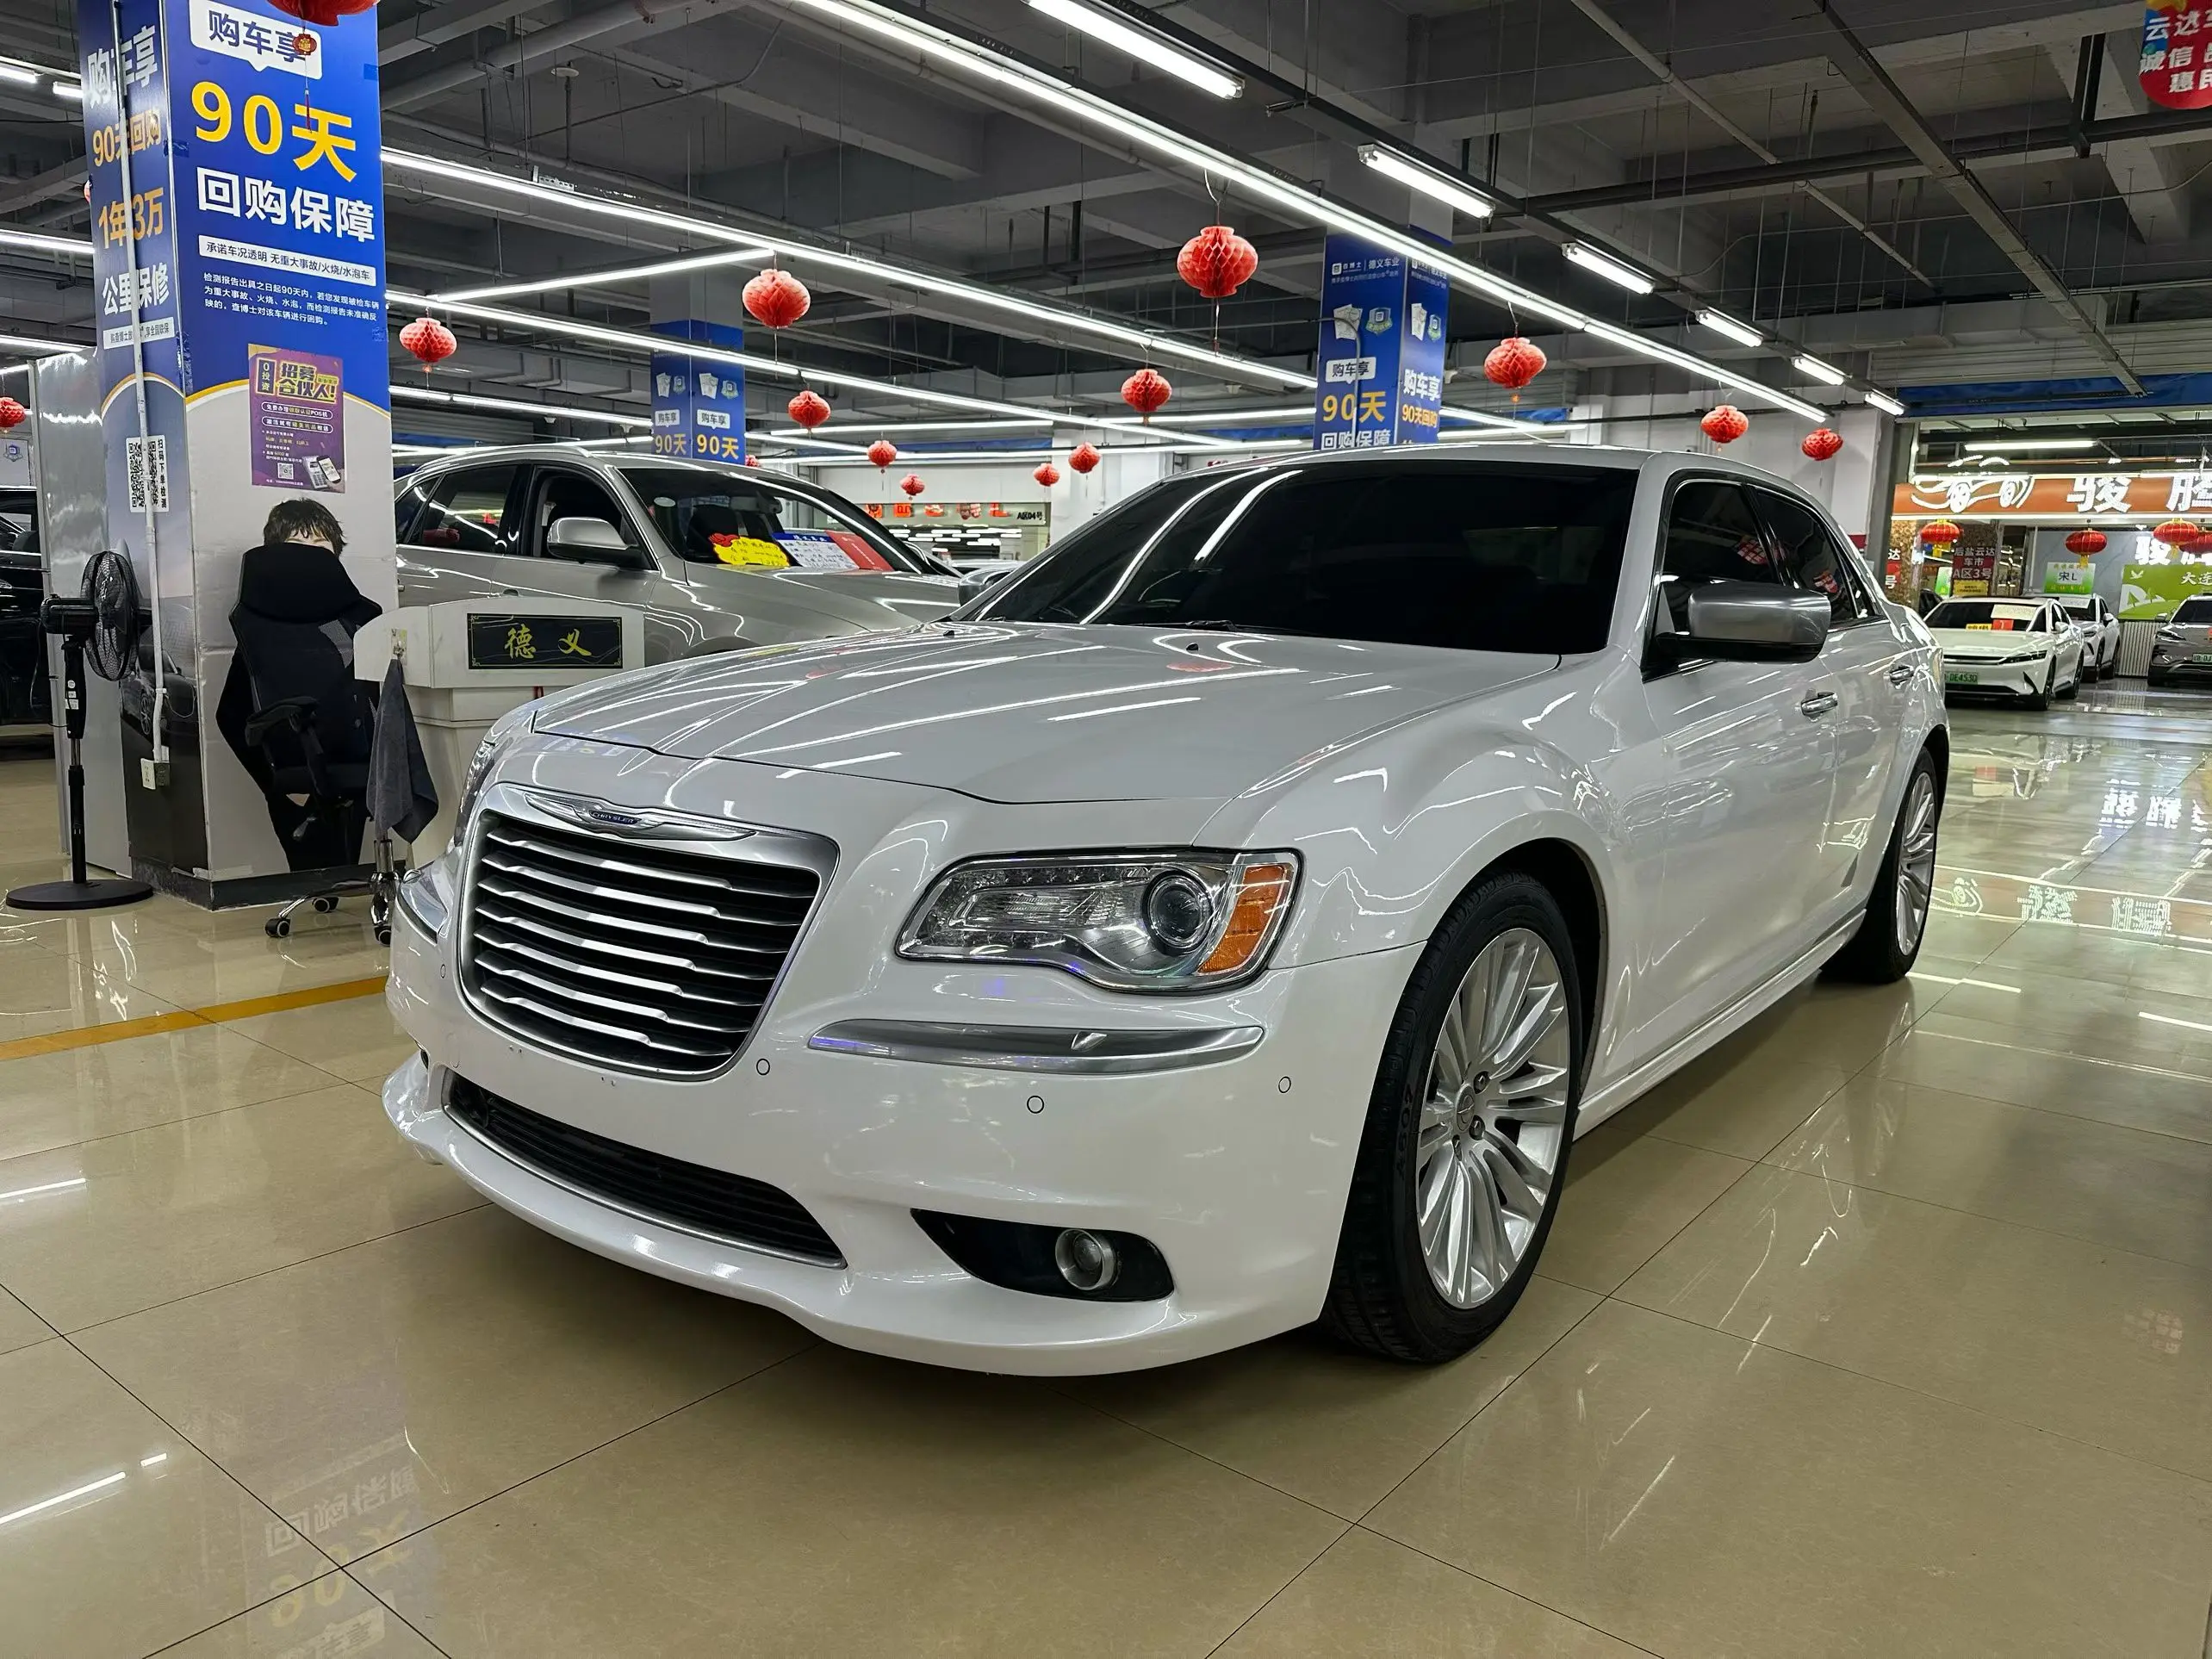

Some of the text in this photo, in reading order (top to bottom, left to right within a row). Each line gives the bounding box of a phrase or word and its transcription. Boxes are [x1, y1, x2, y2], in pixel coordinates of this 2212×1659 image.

[208, 10, 307, 63] 购车享
[191, 81, 357, 182] 90天
[196, 166, 376, 243] 回购保障
[206, 241, 370, 281] 承诺车况透明 无重大事故/火烧/水泡车
[102, 262, 170, 315] 公里保修
[1333, 362, 1369, 376] 购车享
[1404, 368, 1440, 402] 购车享
[701, 412, 726, 426] 购车享
[1323, 391, 1386, 422] 90天
[1401, 403, 1437, 429] 90天回购
[656, 433, 687, 456] 90天
[697, 434, 739, 460] 90天
[1320, 429, 1391, 450] 回购保障
[1954, 547, 1996, 556] 后盐云达
[1964, 557, 1984, 567] 车市
[1953, 568, 1991, 580] A区3号
[504, 624, 592, 660] 德义
[593, 812, 636, 824] CHRYSLER
